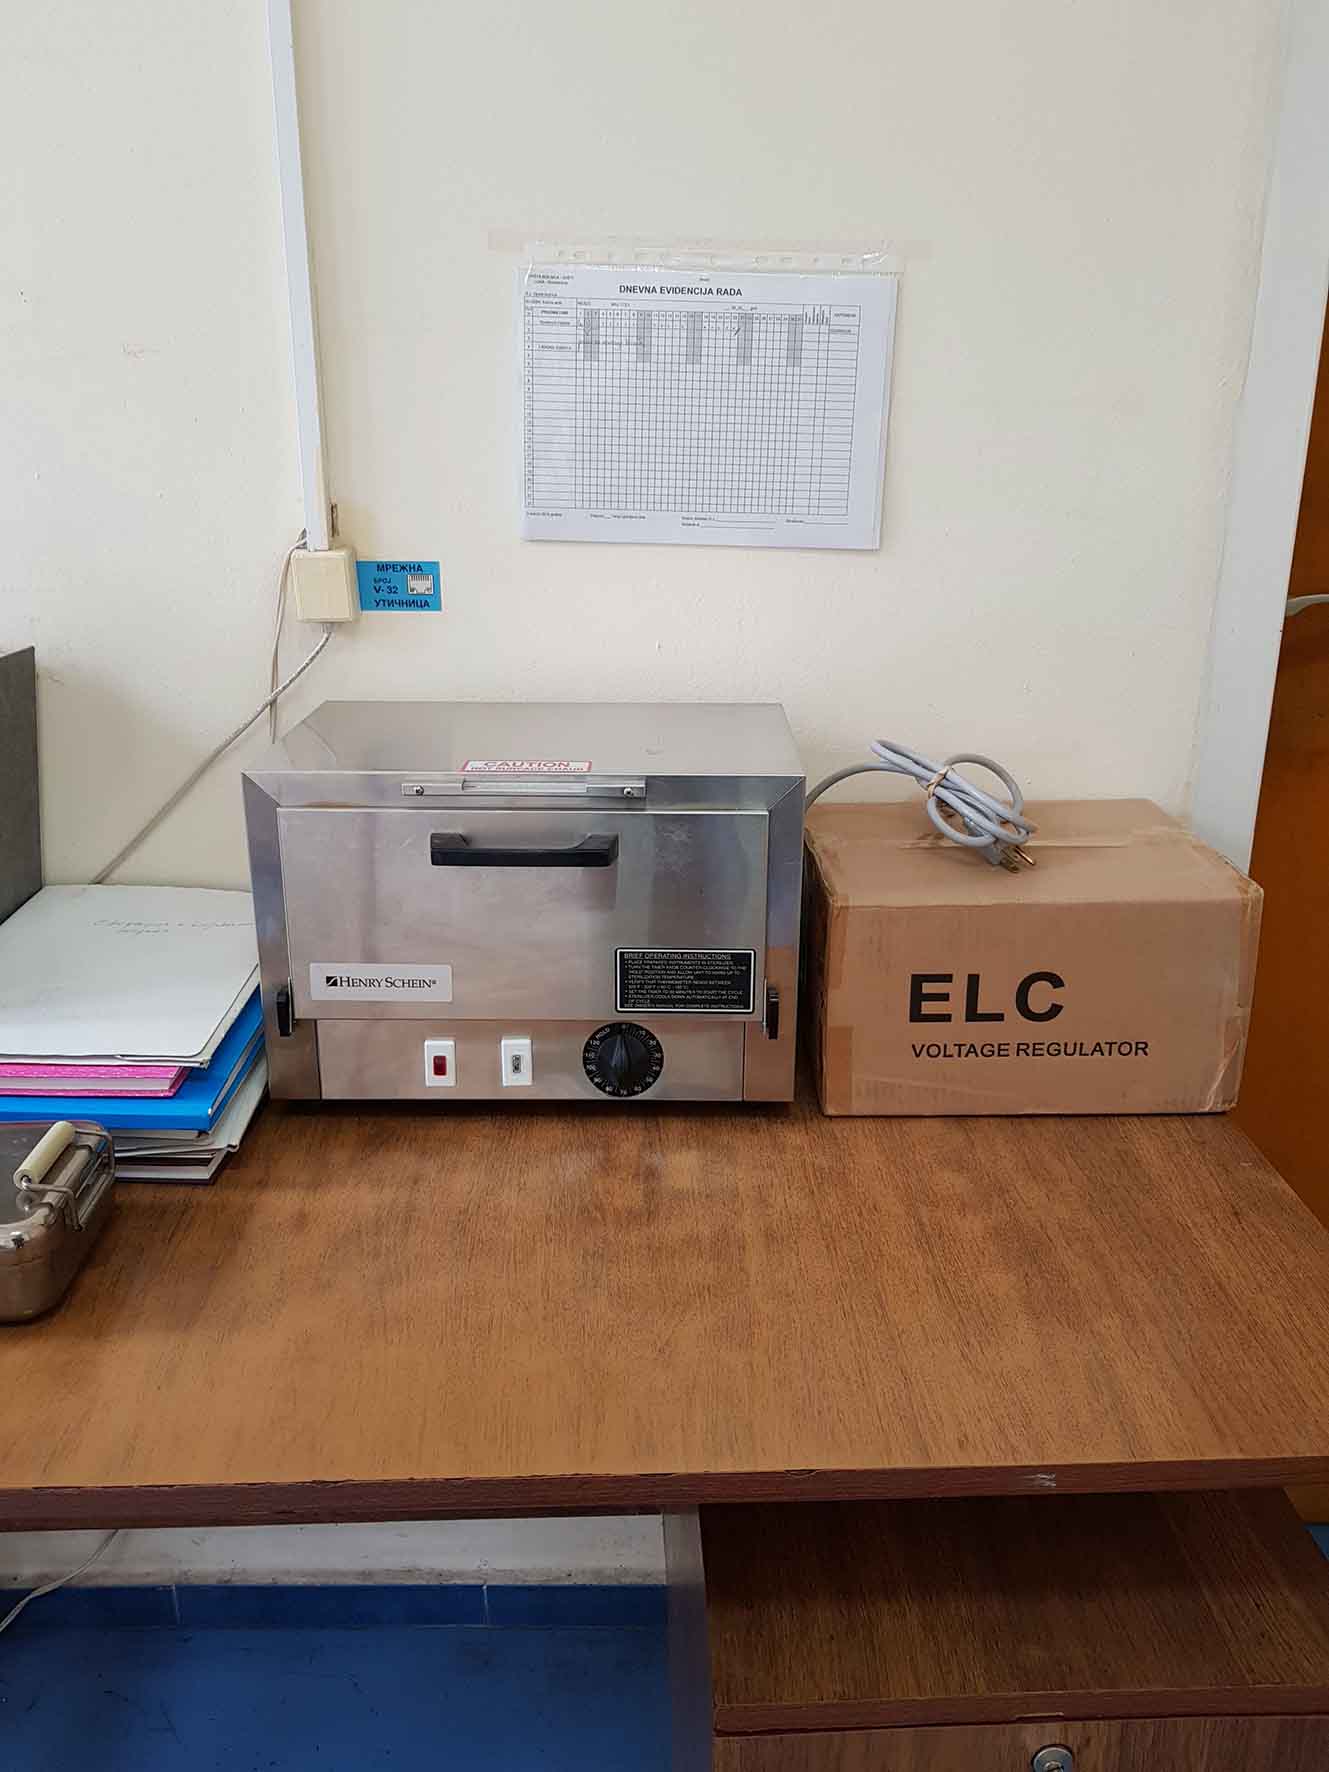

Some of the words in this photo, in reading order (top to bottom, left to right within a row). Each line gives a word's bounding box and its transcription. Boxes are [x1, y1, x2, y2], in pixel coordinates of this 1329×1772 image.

[619, 285, 657, 295] DNEVNA
[660, 286, 714, 296] EVIDENCIJA
[716, 287, 743, 297] RADA
[376, 563, 423, 573] МРЕЖНА
[374, 599, 431, 609] УТИЧНИЦА
[339, 976, 383, 988] HENRY
[908, 971, 1065, 1023] ELC
[911, 1042, 1010, 1058] VOLTAGE
[1015, 1041, 1149, 1058] REGULATOR
